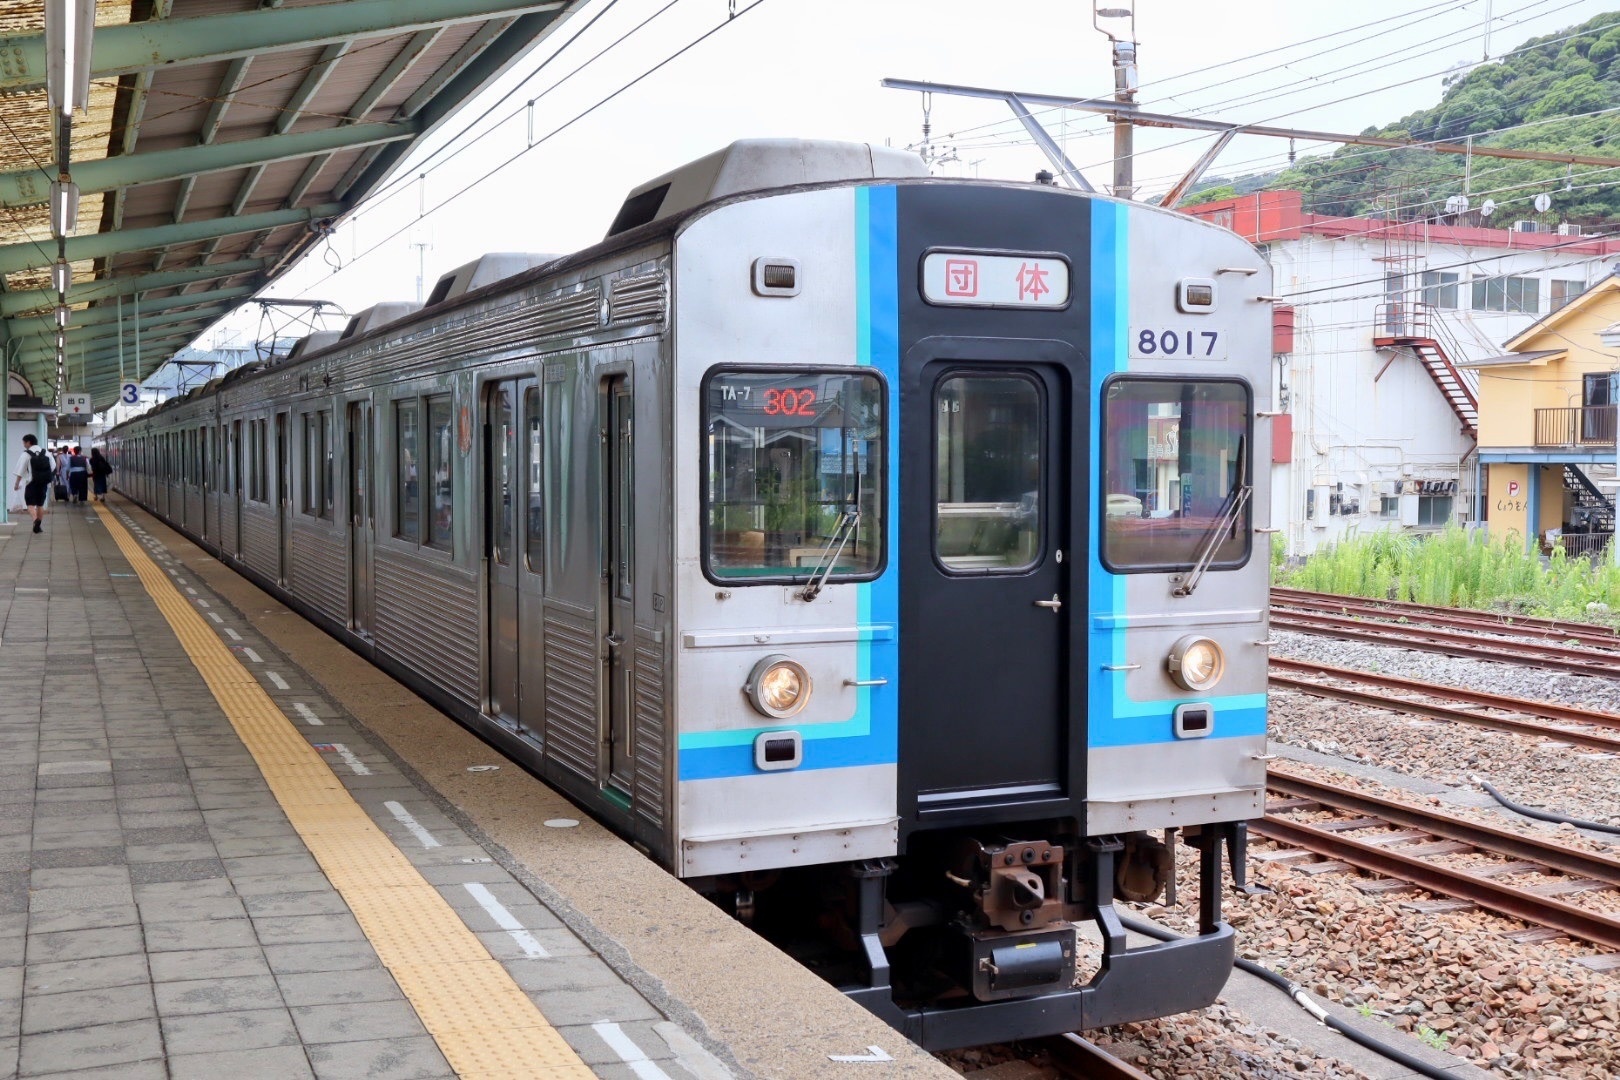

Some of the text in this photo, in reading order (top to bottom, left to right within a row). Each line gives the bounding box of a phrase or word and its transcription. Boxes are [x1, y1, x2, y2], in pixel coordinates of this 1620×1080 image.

[945, 259, 1050, 301] 団体
[1138, 329, 1218, 356] 8017
[122, 383, 139, 404] 3
[721, 385, 751, 401] TA-7
[763, 387, 816, 416] 302
[1509, 481, 1519, 495] P
